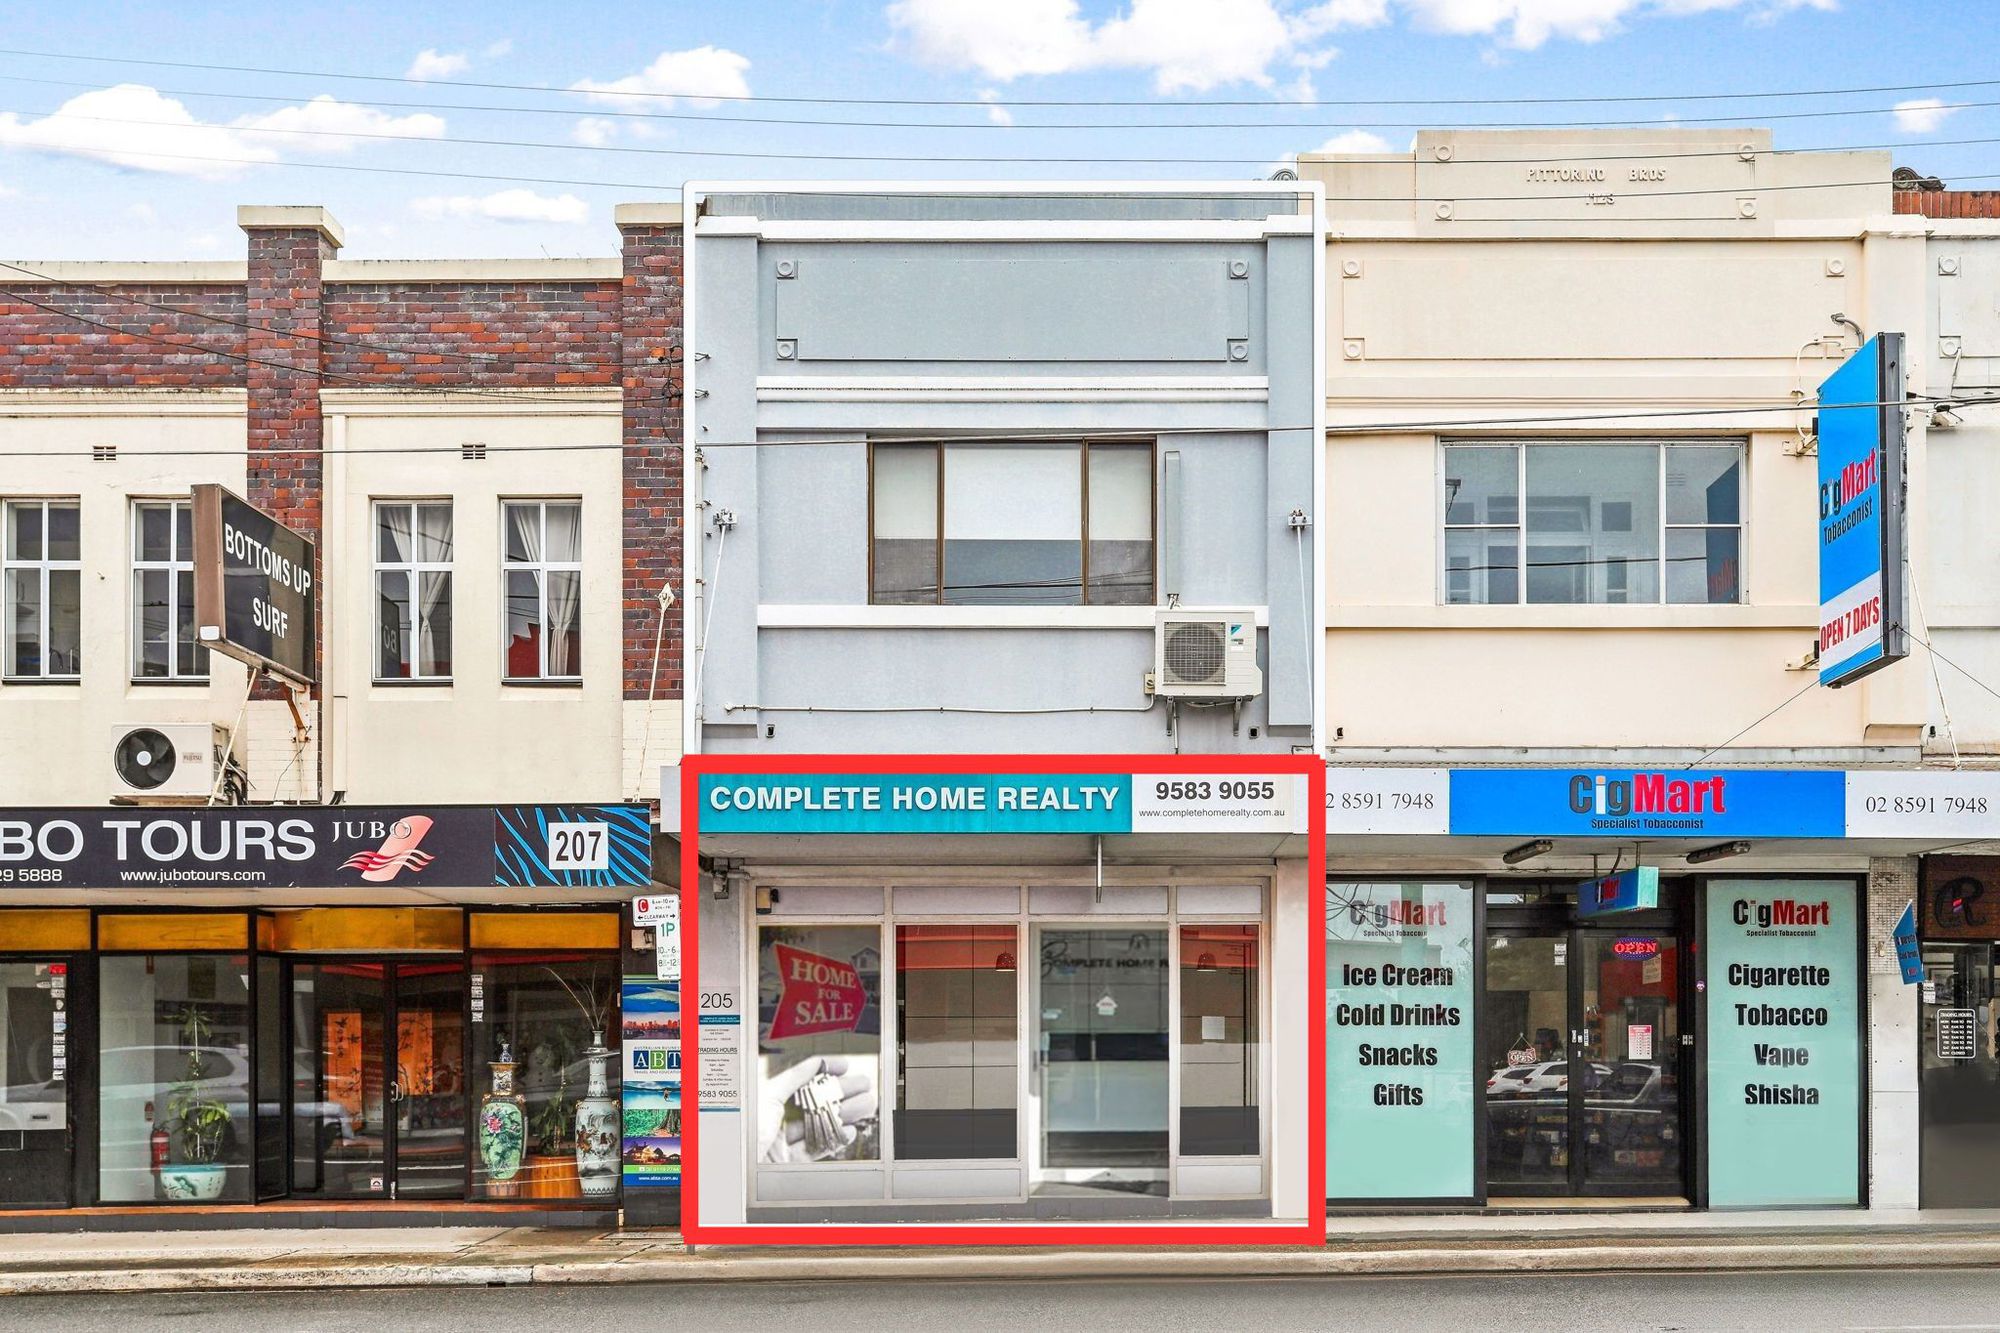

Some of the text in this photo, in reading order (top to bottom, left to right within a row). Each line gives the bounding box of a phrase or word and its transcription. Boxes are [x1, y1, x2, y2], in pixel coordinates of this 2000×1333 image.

[1526, 167, 1667, 182] PITTORINO BROS
[1819, 447, 1877, 521] CigMart
[1823, 498, 1873, 546] Tobacconist
[225, 523, 311, 596] BOTTOMS UP
[253, 597, 288, 638] SURF
[1820, 596, 1879, 652] OPEN 7 DAYS
[710, 786, 1119, 811] COMPLETE HOME REALTY
[1156, 781, 1275, 800] 9583 9055
[1326, 792, 1434, 810] 2 8591 7948
[1568, 774, 1727, 816] CigMart
[1139, 808, 1285, 819] www.completehomerealty.com.au
[1865, 796, 1988, 814] 02 8591 7948
[332, 821, 411, 842] JUBO
[1591, 818, 1704, 830] Specialist Tobacconist
[103, 819, 316, 861] TOURS
[555, 830, 602, 862] 207
[18, 869, 63, 882] 5888
[120, 868, 266, 883] www.jubotours.com
[638, 900, 648, 912] C
[1350, 899, 1448, 928] CigMart
[1733, 899, 1830, 928] CigMart
[661, 922, 676, 937] 1P
[1746, 929, 1817, 937] Specialist Tobacconist
[1614, 942, 1657, 953] OPEN
[789, 957, 857, 989] HOME
[1343, 963, 1453, 986] Ice Cream
[1728, 963, 1830, 988] Cigarette
[701, 993, 733, 1008] 205
[817, 988, 842, 1000] FOR
[794, 1000, 855, 1025] SALE
[1336, 1003, 1460, 1026] Cold Drinks
[1735, 1003, 1828, 1026] Tobacco
[1359, 1043, 1438, 1066] Snacks
[1754, 1043, 1809, 1068] Vape
[698, 1090, 738, 1098] 9583 9055
[1373, 1083, 1423, 1106] Gifts
[1744, 1083, 1819, 1105] Shisha
